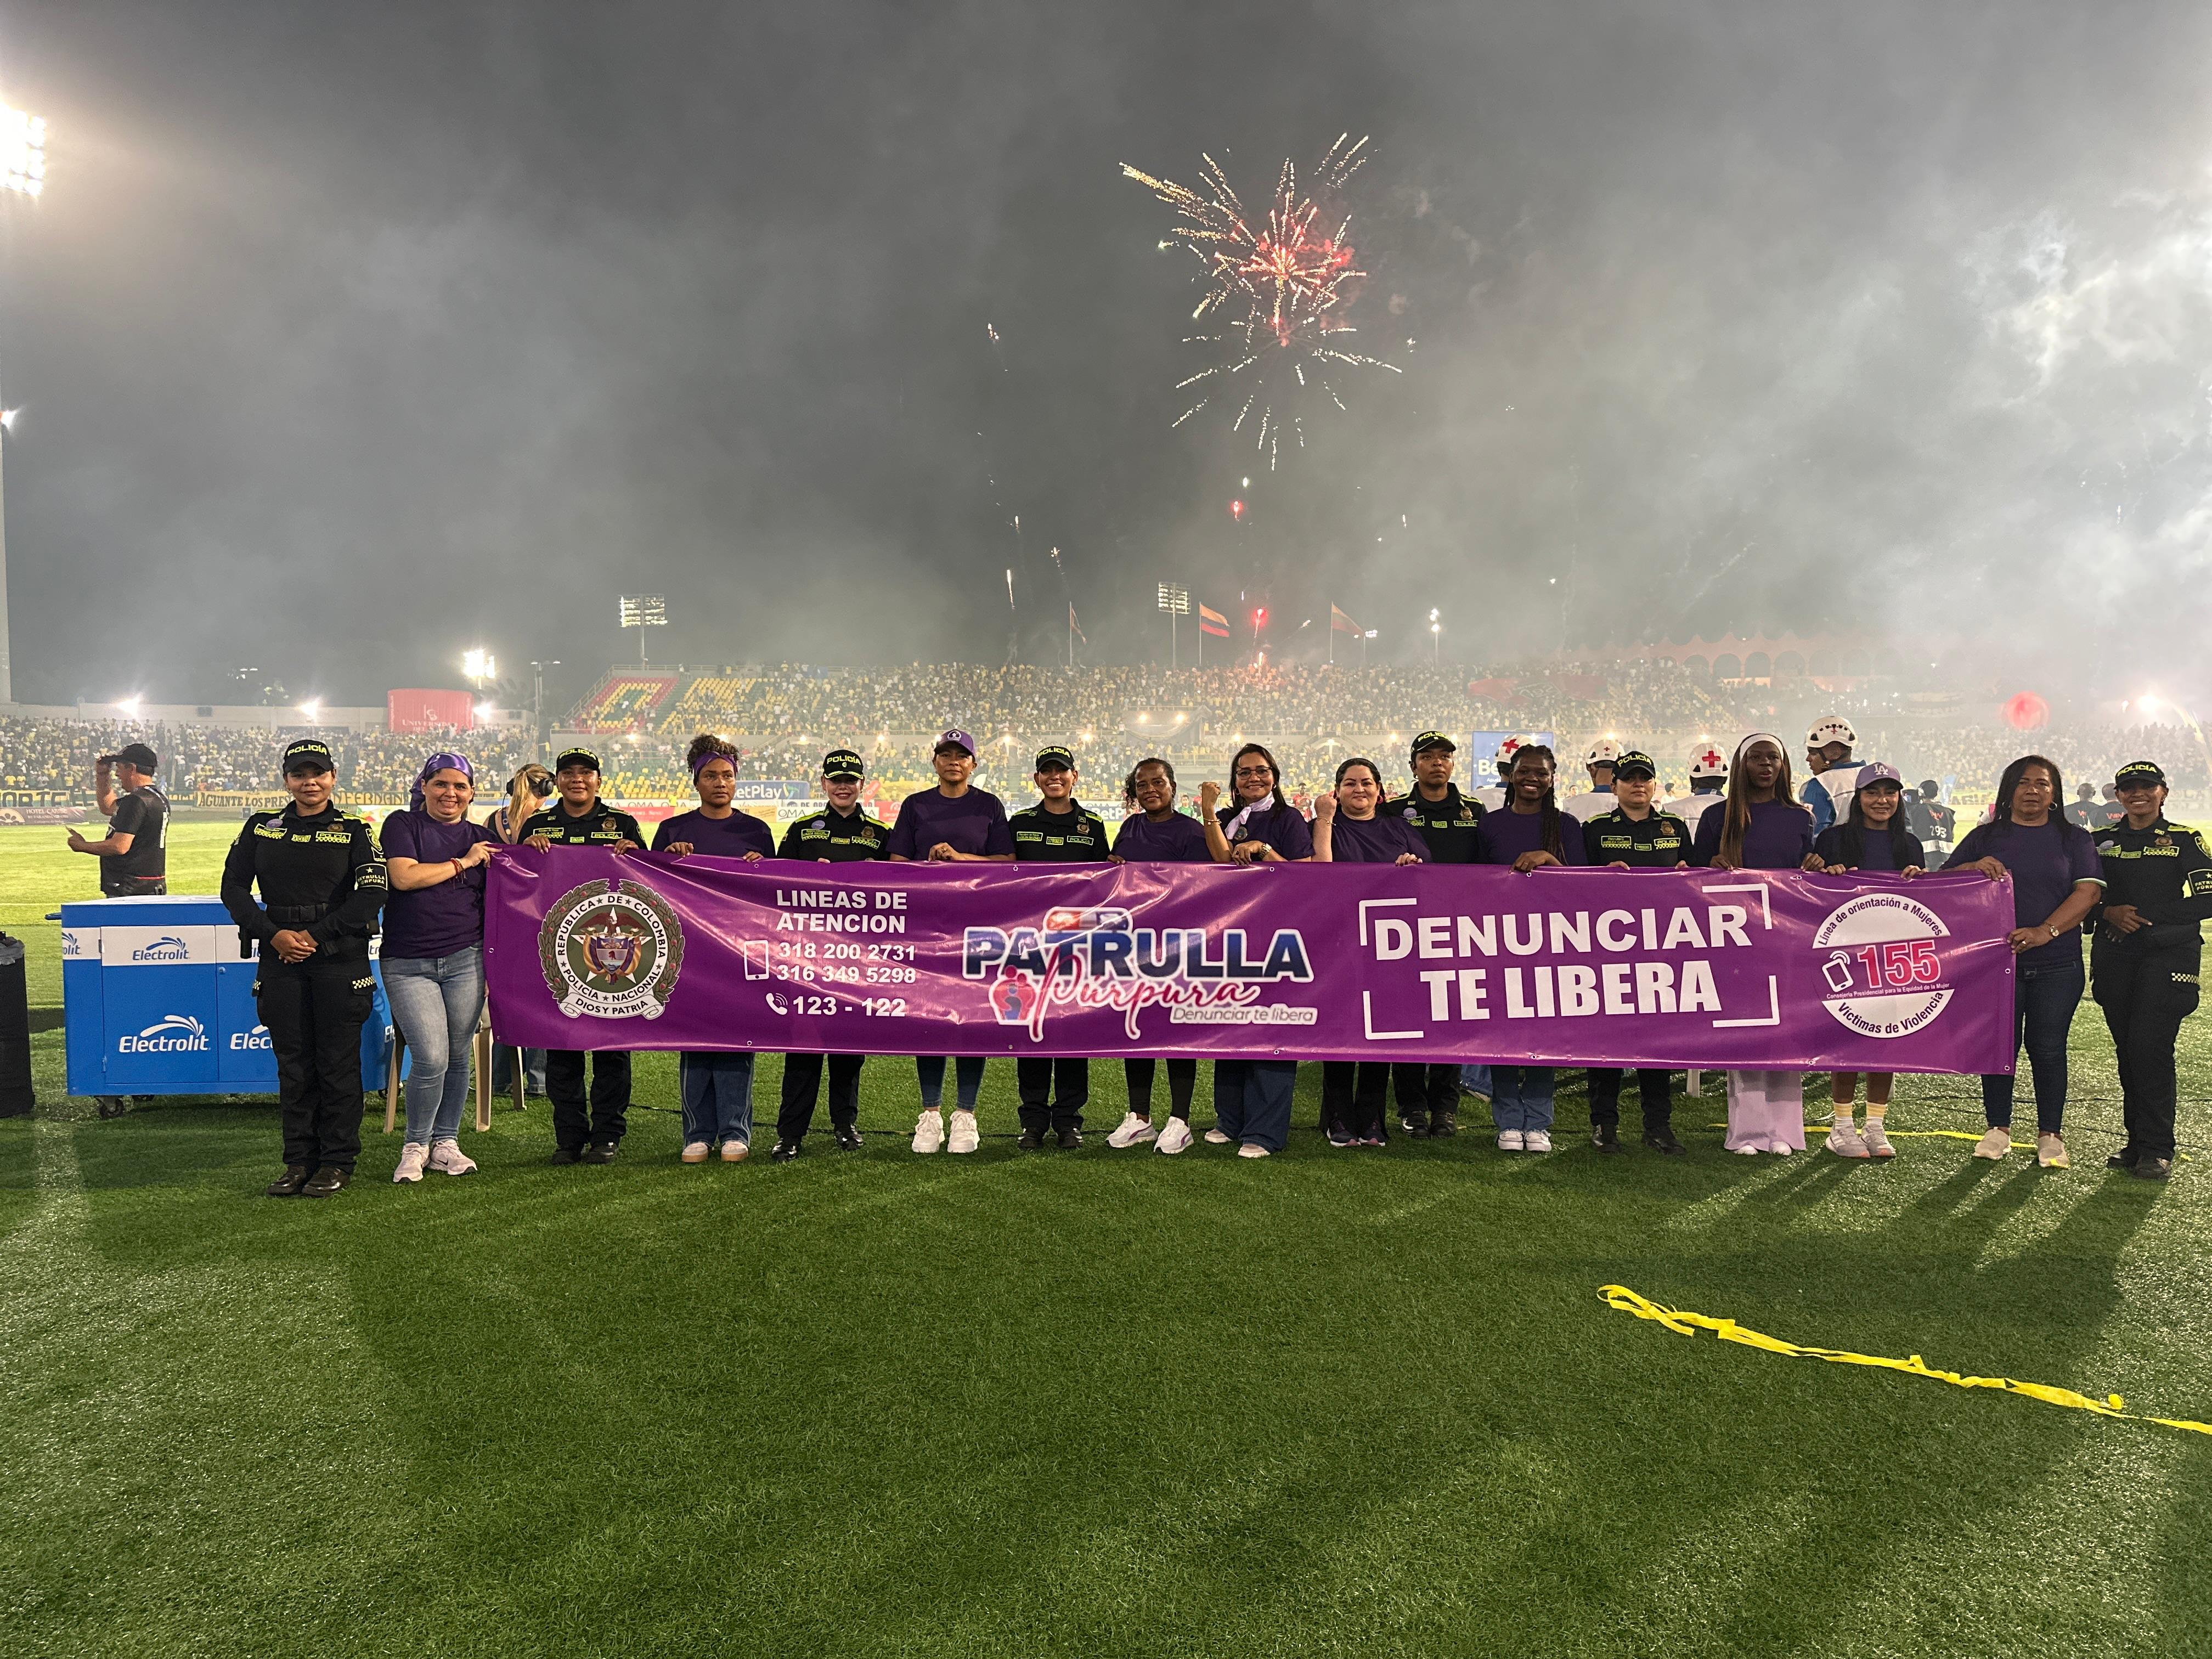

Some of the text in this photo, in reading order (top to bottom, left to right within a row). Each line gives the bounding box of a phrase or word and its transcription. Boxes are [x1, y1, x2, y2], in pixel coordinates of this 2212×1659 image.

[1873, 763, 1889, 775] LA
[199, 792, 243, 807] AGUANTE
[245, 796, 262, 807] LOS
[778, 809, 805, 818] OMA
[1929, 825, 1947, 838] 293
[776, 889, 907, 910] LINEAS DE
[557, 895, 666, 958] REPÚBLICA DE COLOMBIA
[776, 912, 905, 934] ATENCION
[1818, 923, 1837, 946] Línea
[1836, 911, 1848, 923] de
[1848, 897, 1901, 915] orientación
[1910, 905, 1943, 936] Mujeres
[1374, 905, 1752, 961] DENUNCIAR
[132, 949, 189, 961] Electrolit
[778, 942, 915, 961] 318 200 2731
[964, 928, 1312, 981] PATRULLA
[776, 964, 916, 984] 316 349 5298
[1857, 939, 1941, 989] 155
[563, 969, 661, 1002] POLICÍA NACIONAL
[1032, 947, 1258, 1039] Púrpura
[1420, 960, 1722, 1022] TE LIBERA
[575, 998, 601, 1013] DIOS
[612, 1000, 648, 1014] PATRIA
[793, 996, 837, 1015] 123
[861, 997, 906, 1017] 122
[1173, 1006, 1313, 1022] Denunciar te libera
[1838, 992, 1944, 1034] Víctimas de Violencia
[119, 1035, 209, 1053] Electrolit
